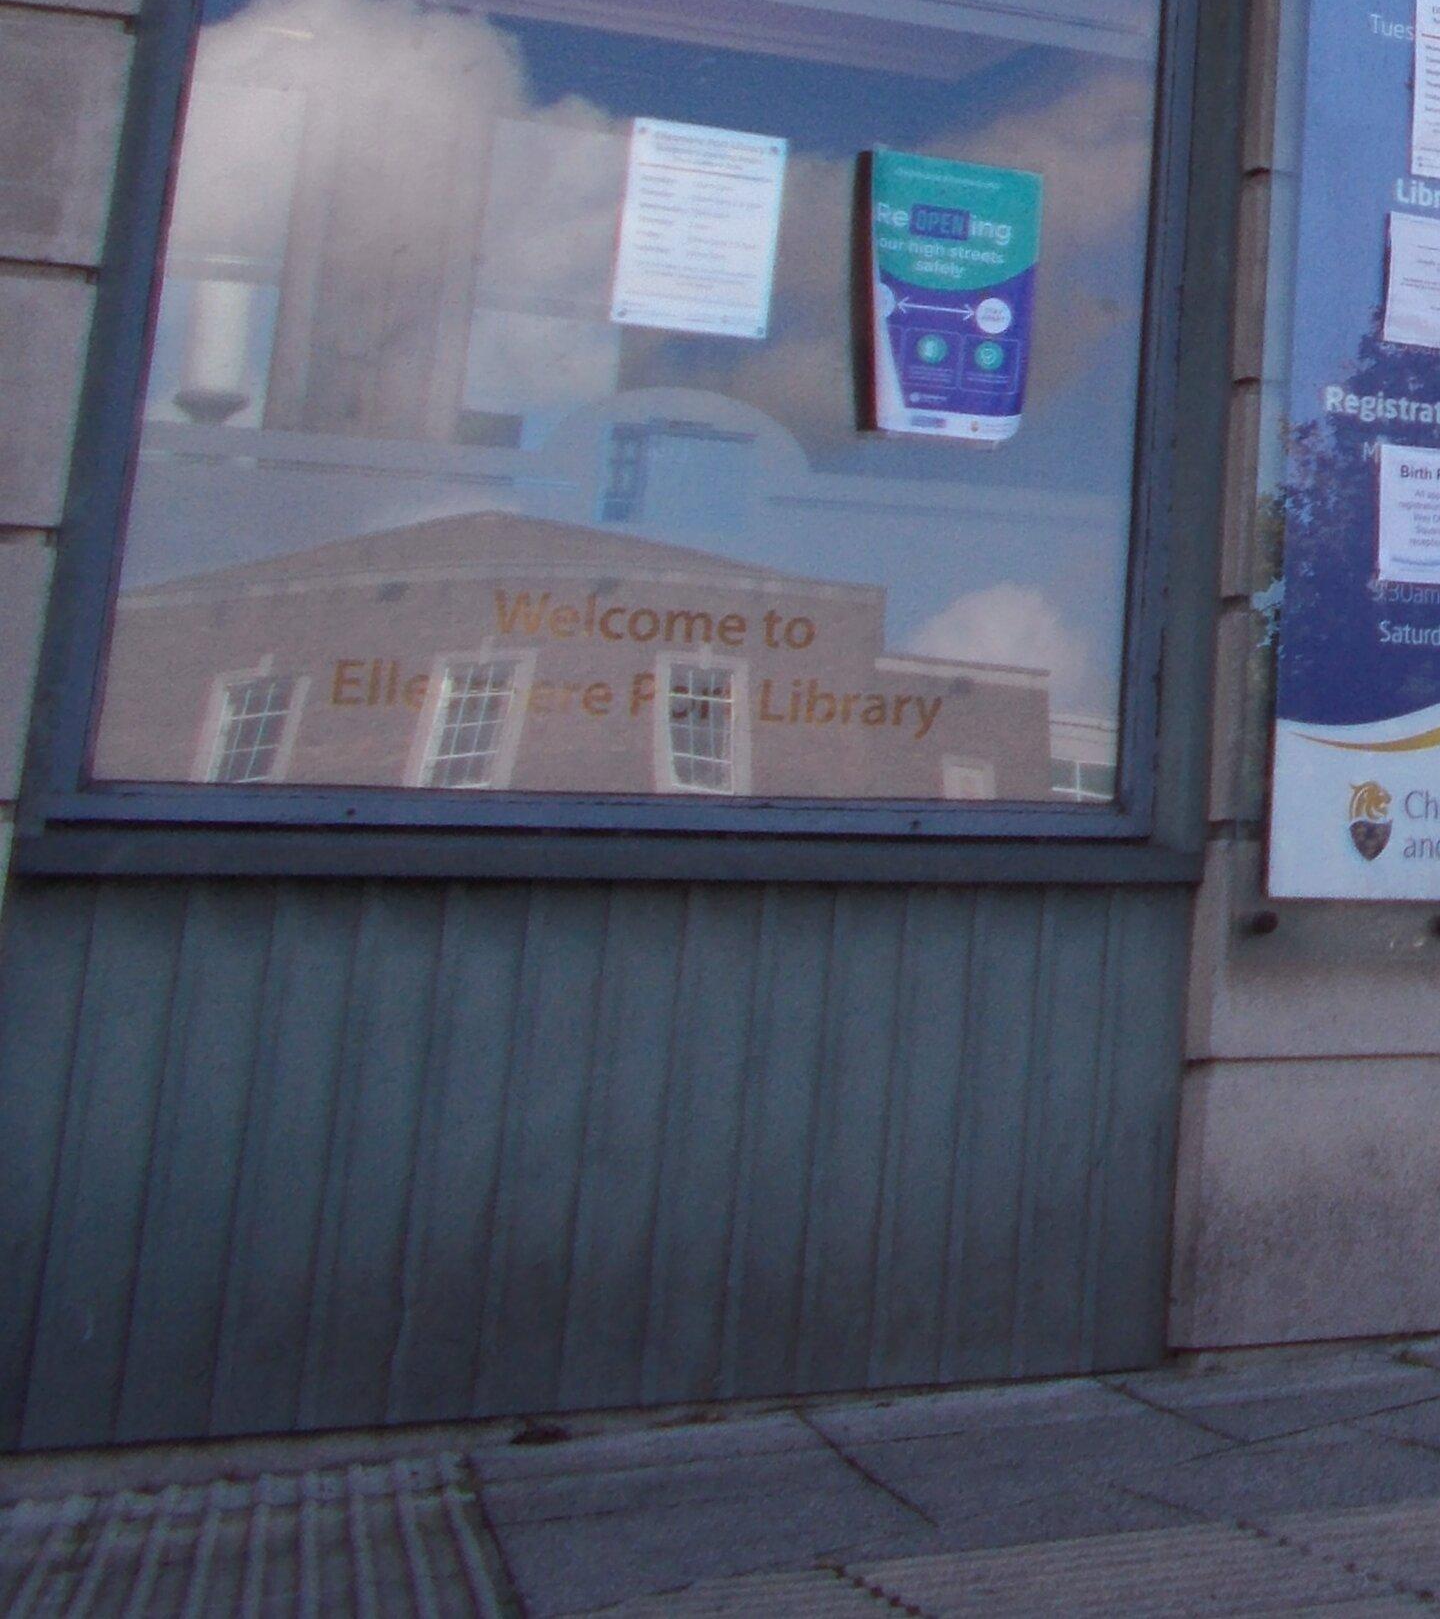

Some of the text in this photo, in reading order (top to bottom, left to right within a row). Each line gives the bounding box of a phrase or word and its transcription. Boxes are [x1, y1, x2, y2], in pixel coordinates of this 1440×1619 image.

[1370, 13, 1416, 41] Tues
[879, 237, 903, 251] our
[950, 246, 1004, 264] streets
[915, 259, 966, 278] safely
[1400, 464, 1432, 480] Birth
[496, 589, 817, 649] Welcome to
[329, 657, 614, 717] Elleere
[758, 679, 944, 740] Library
